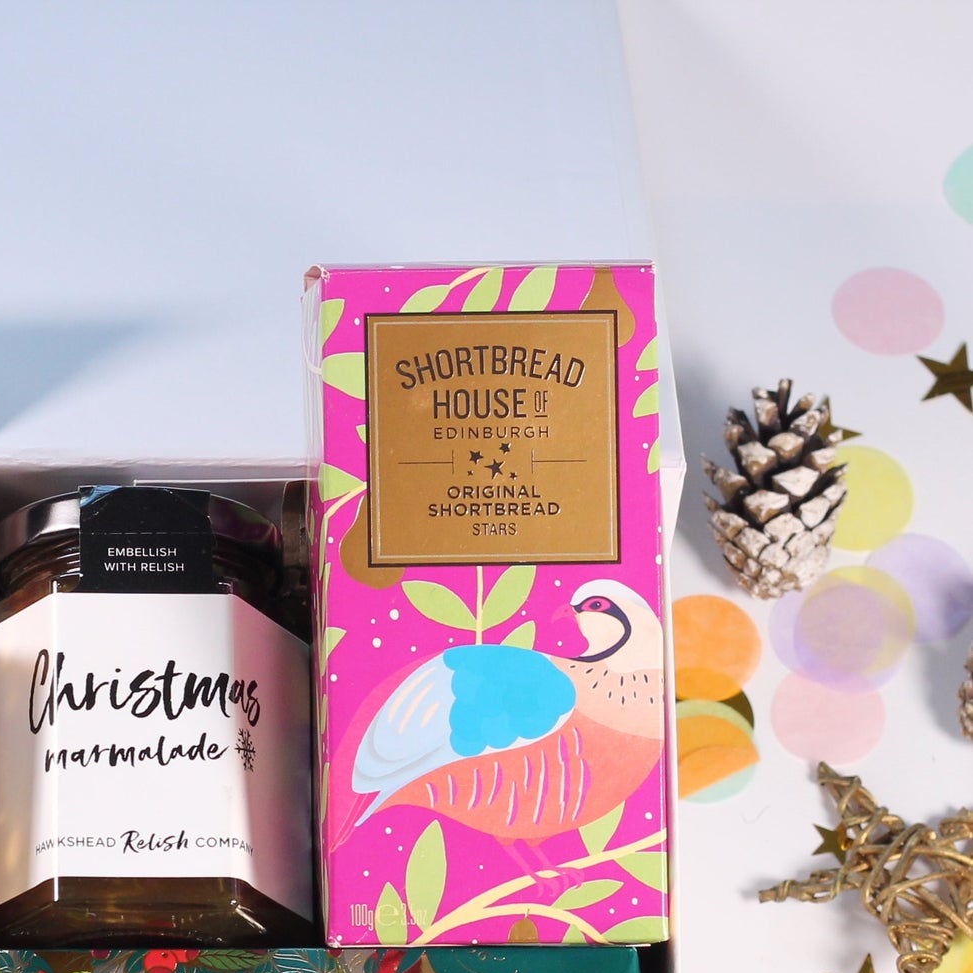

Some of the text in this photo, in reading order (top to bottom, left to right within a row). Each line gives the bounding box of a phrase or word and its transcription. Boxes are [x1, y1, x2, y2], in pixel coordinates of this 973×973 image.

[395, 345, 586, 390] SHORTBREAD
[433, 389, 549, 419] HOUSE OF
[433, 426, 550, 440] EDINBURGH
[447, 485, 541, 499] ORIGINAL
[428, 502, 561, 517] SHORTBREAD
[472, 522, 517, 536] STARS
[107, 547, 177, 557] EMBELLISH
[104, 562, 185, 572] WITH RELISH
[29, 648, 261, 735] Christmas
[45, 733, 231, 773] marmalade
[35, 830, 253, 857] HAWKSHEAD Relish COMPANY
[350, 903, 374, 931] 100g
